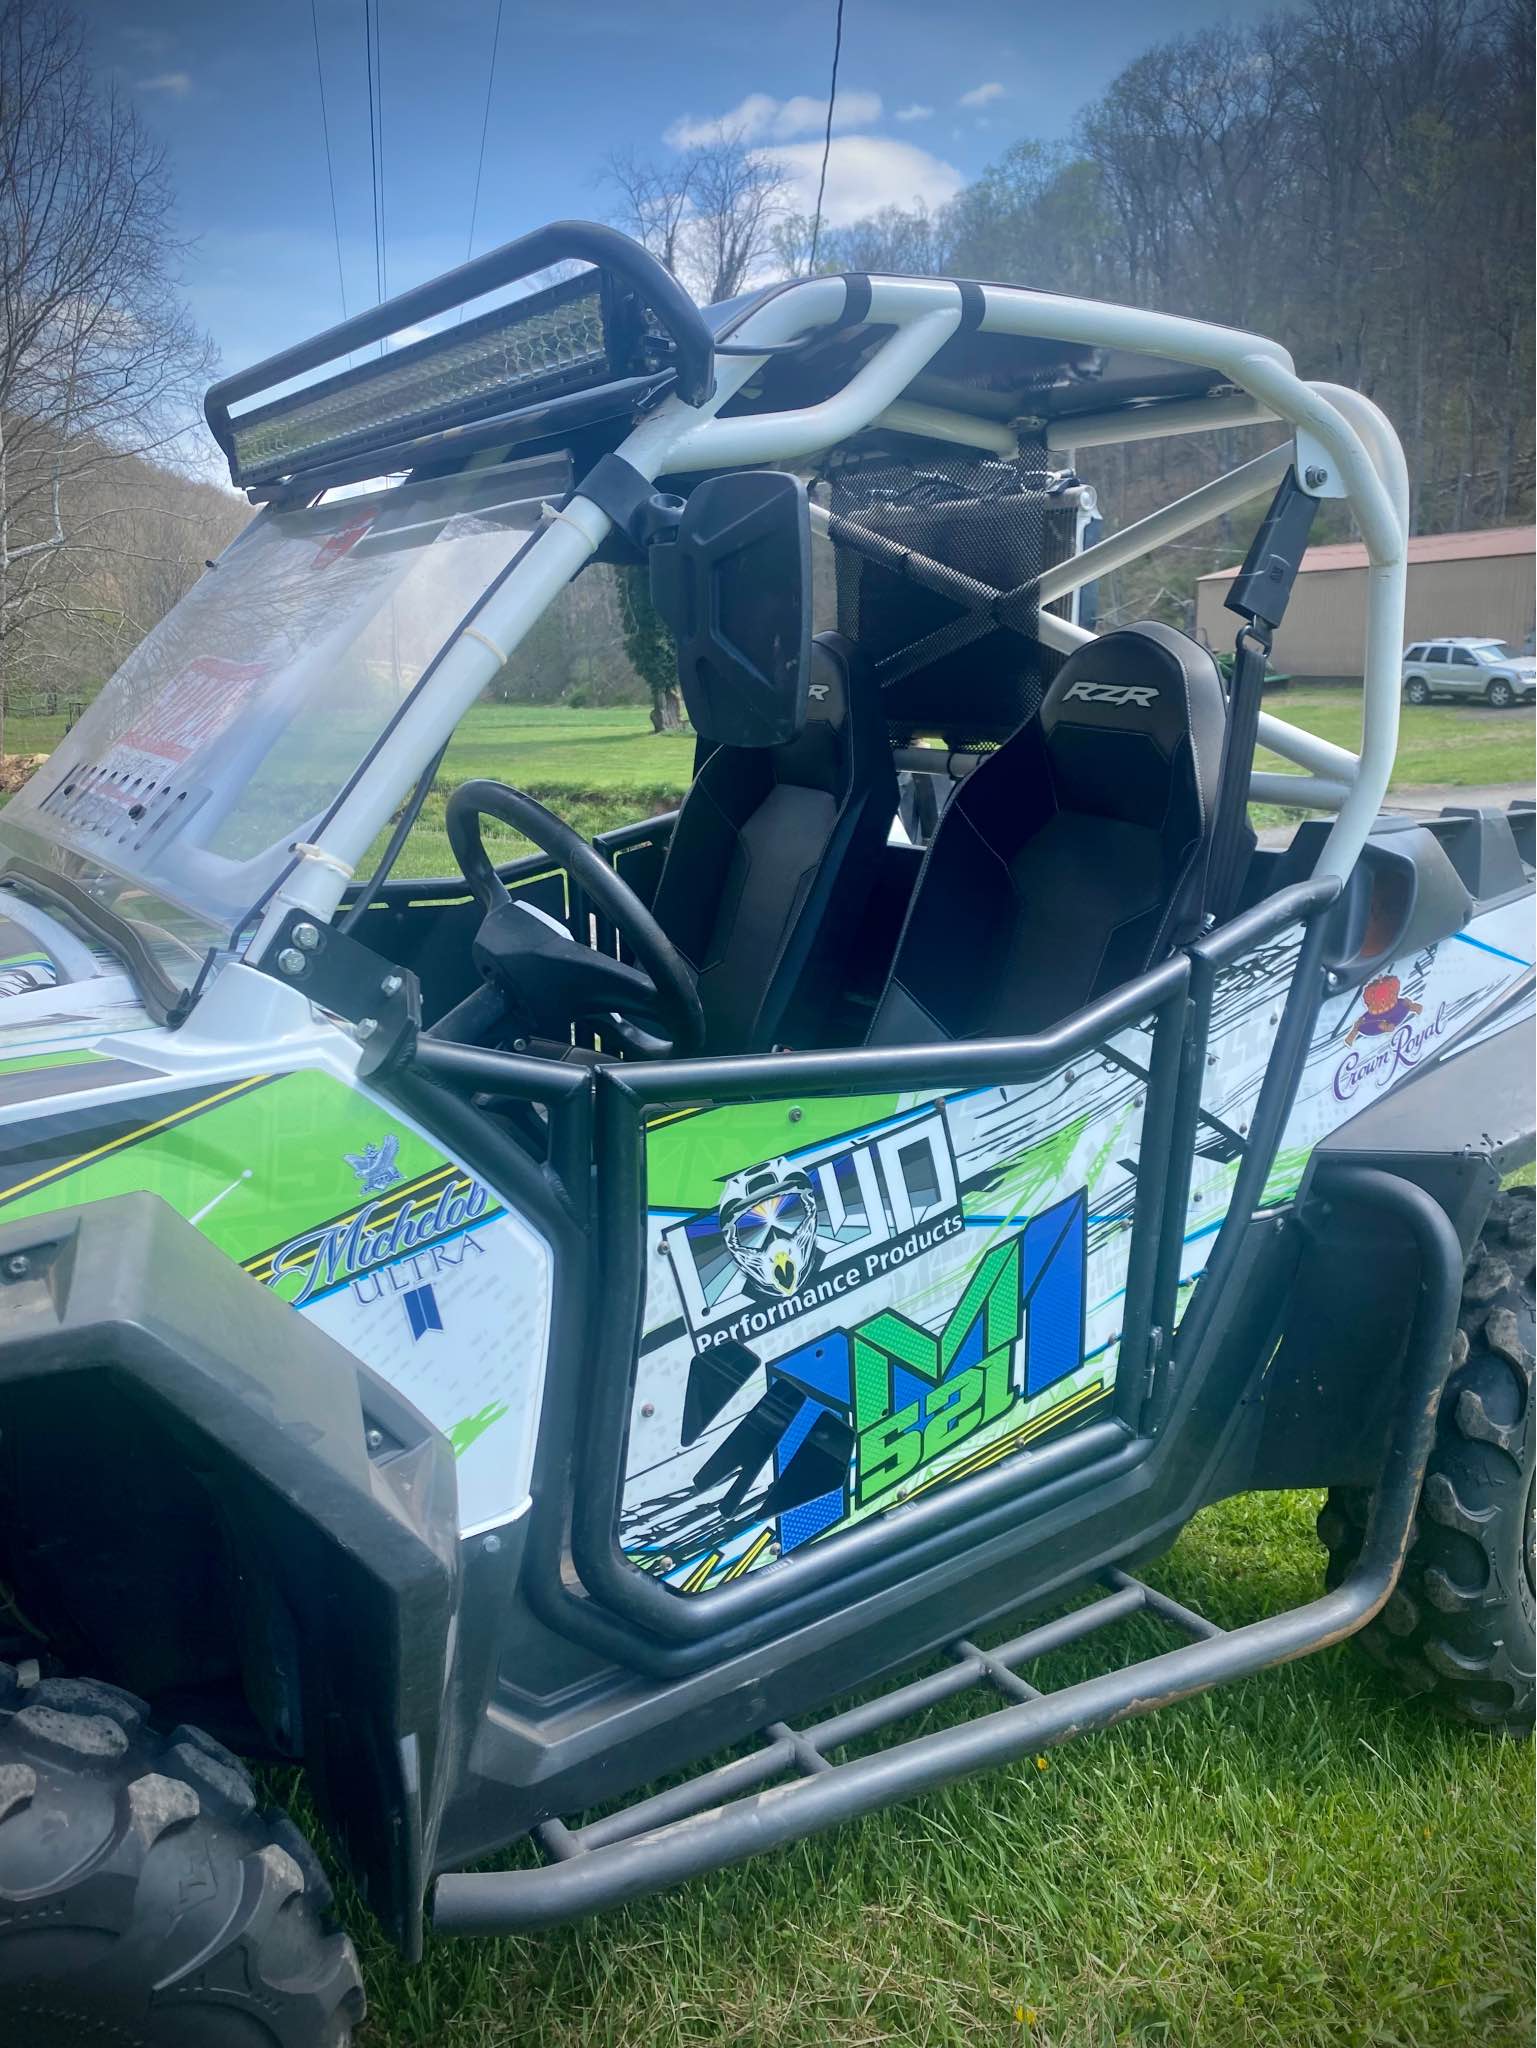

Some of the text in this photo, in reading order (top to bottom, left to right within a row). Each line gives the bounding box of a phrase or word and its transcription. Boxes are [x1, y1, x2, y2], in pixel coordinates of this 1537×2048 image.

[1062, 681, 1160, 707] RZR
[1333, 1001, 1446, 1101] Crown Royal
[267, 1179, 489, 1307] Michelob
[352, 1231, 486, 1306] ULTRA
[664, 1114, 958, 1332] LUD
[696, 1213, 964, 1353] Performance Products
[860, 1344, 1015, 1502] 521
